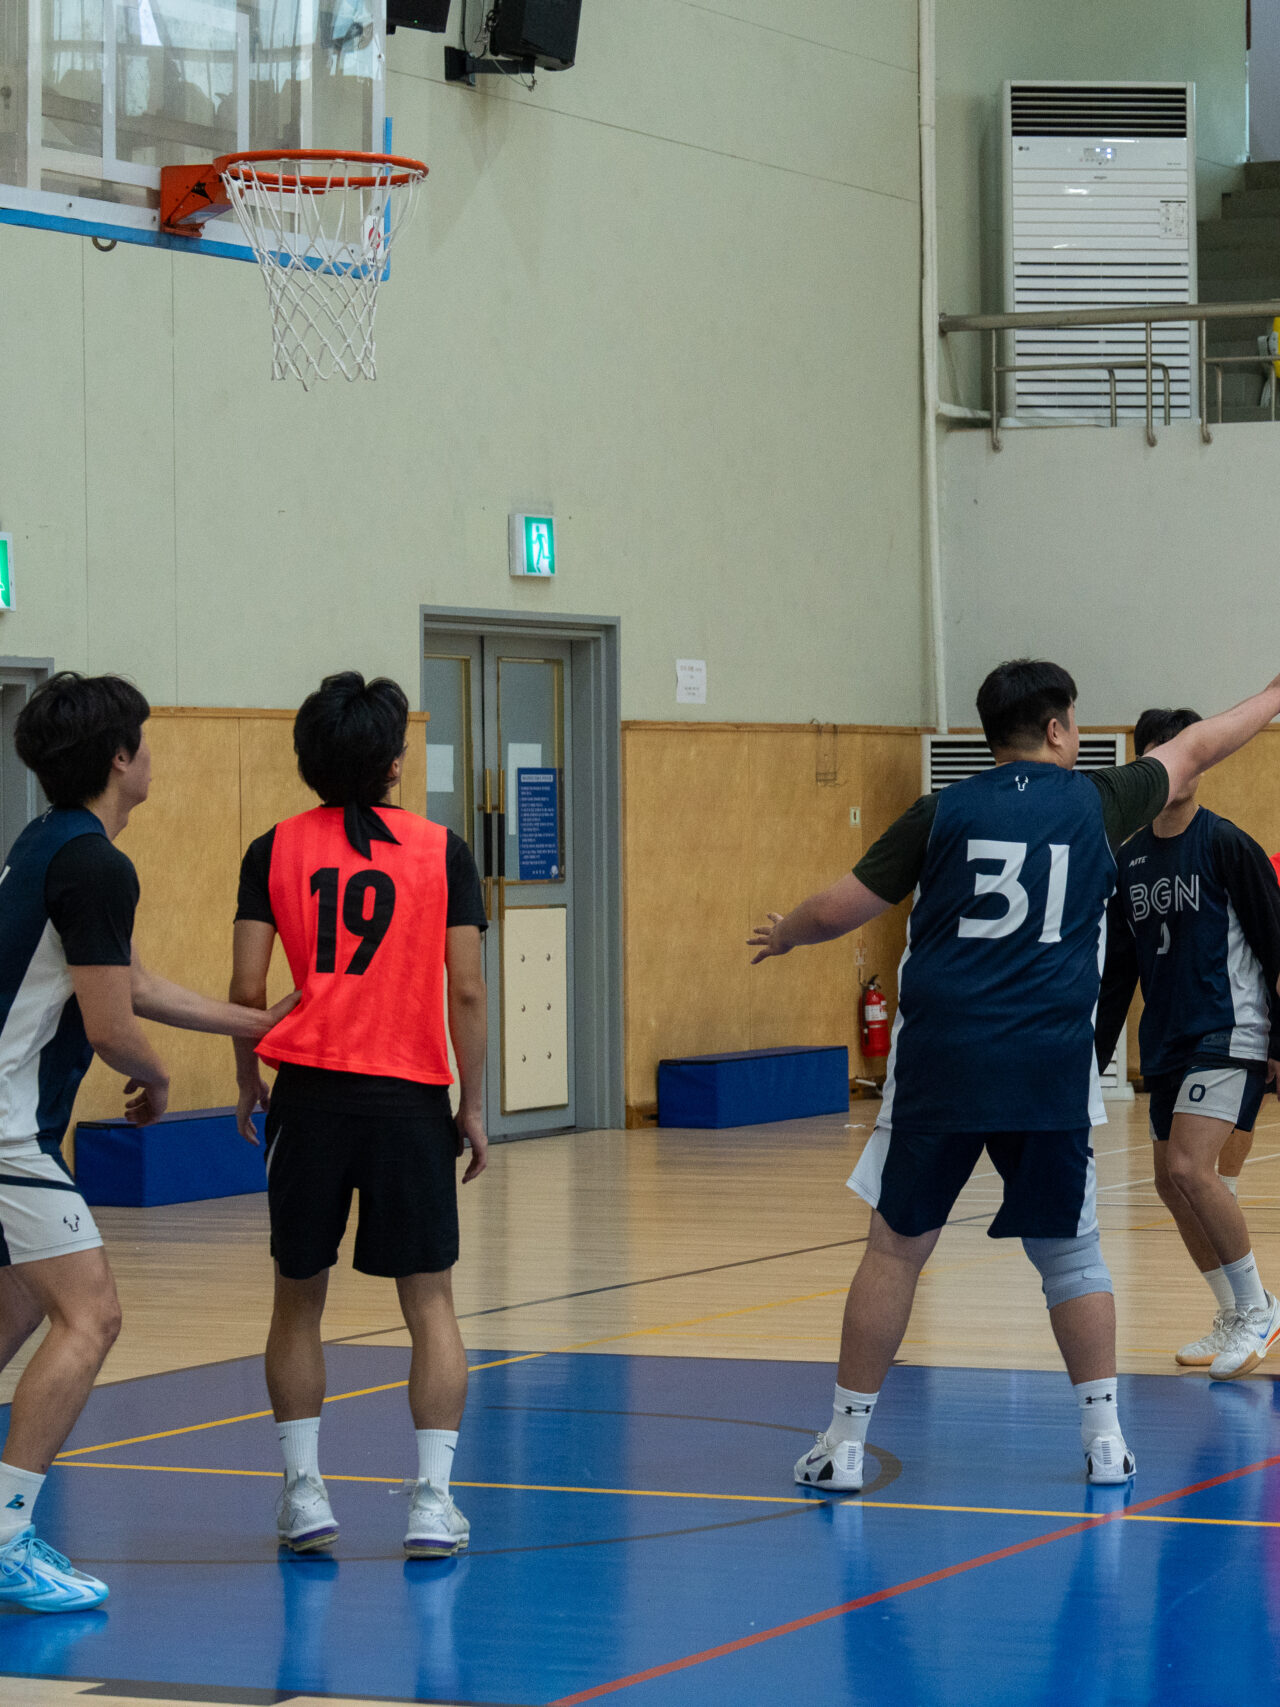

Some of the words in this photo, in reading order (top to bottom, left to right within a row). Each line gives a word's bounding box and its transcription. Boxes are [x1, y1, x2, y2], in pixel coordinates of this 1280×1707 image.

[309, 867, 397, 976] 19
[957, 839, 1070, 943] 31
[1129, 874, 1200, 922] BGN
